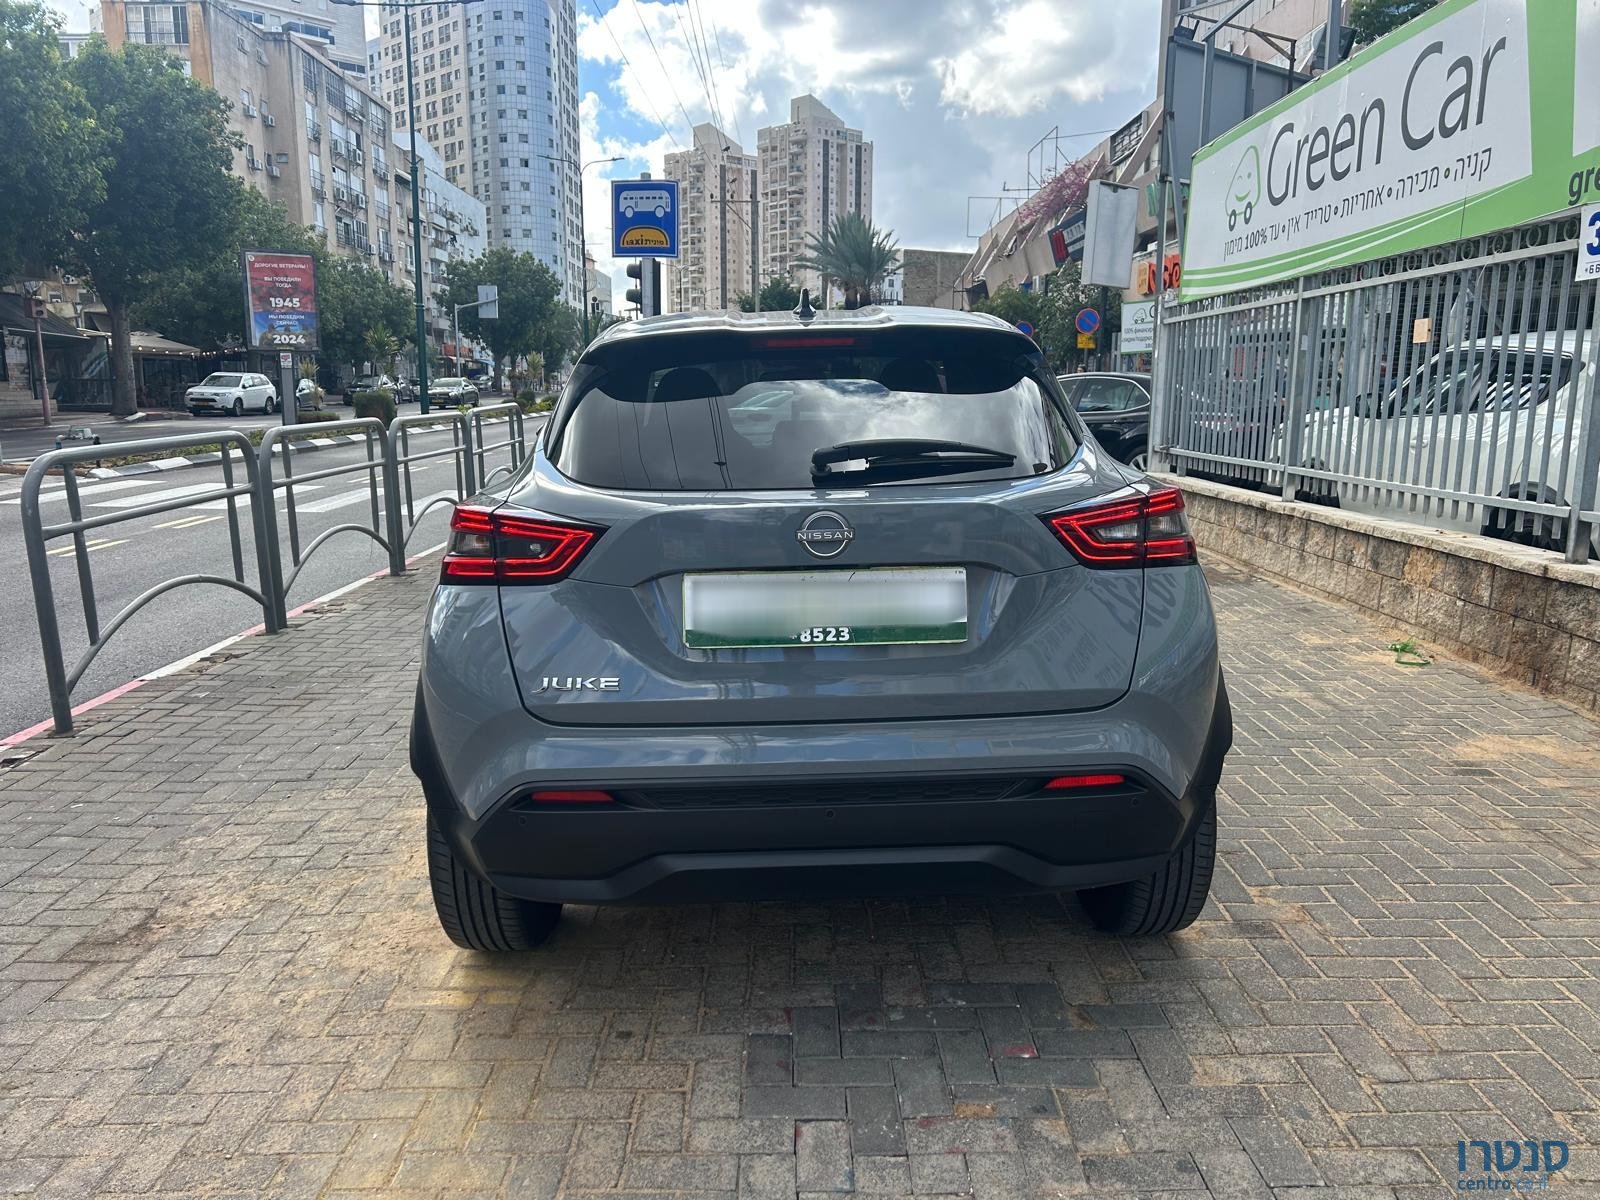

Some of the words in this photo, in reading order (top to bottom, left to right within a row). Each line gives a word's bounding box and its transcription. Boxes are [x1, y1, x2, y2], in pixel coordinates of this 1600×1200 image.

[1267, 97, 1385, 207] Green
[1401, 36, 1507, 151] Car
[1453, 147, 1492, 182] קניה
[1395, 166, 1440, 200] מכירה
[1340, 184, 1385, 218] אחריות
[1286, 214, 1302, 241] אין
[1304, 203, 1332, 229] טרייד
[1245, 228, 1268, 250] 100%
[1269, 222, 1281, 240] עד
[1223, 236, 1243, 262] מימון
[269, 297, 301, 308] 1945
[272, 334, 306, 344] 2024
[797, 530, 853, 541] NISSAN
[532, 675, 621, 693] JUKE
